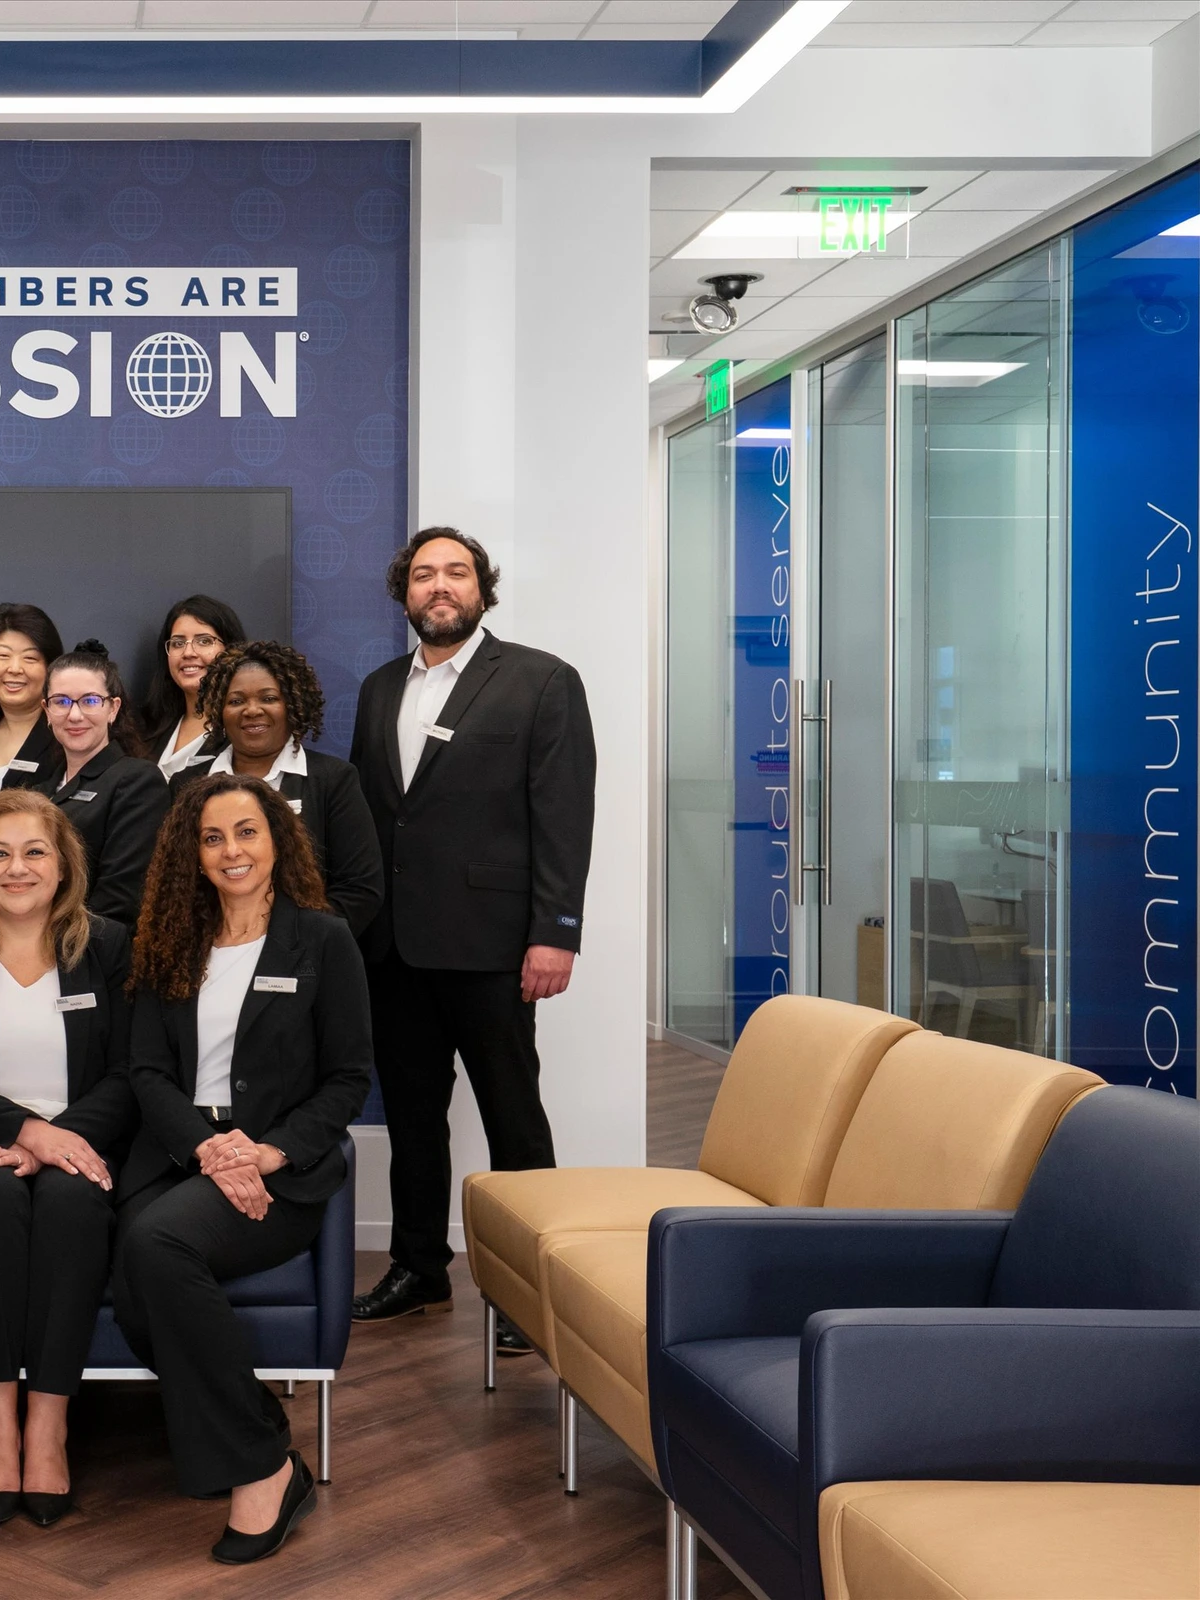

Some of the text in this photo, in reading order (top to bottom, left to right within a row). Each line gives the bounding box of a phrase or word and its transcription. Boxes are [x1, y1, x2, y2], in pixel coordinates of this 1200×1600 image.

[819, 196, 893, 252] EXIT
[180, 275, 280, 308] ARE
[771, 444, 791, 648] serve
[766, 678, 790, 754] to
